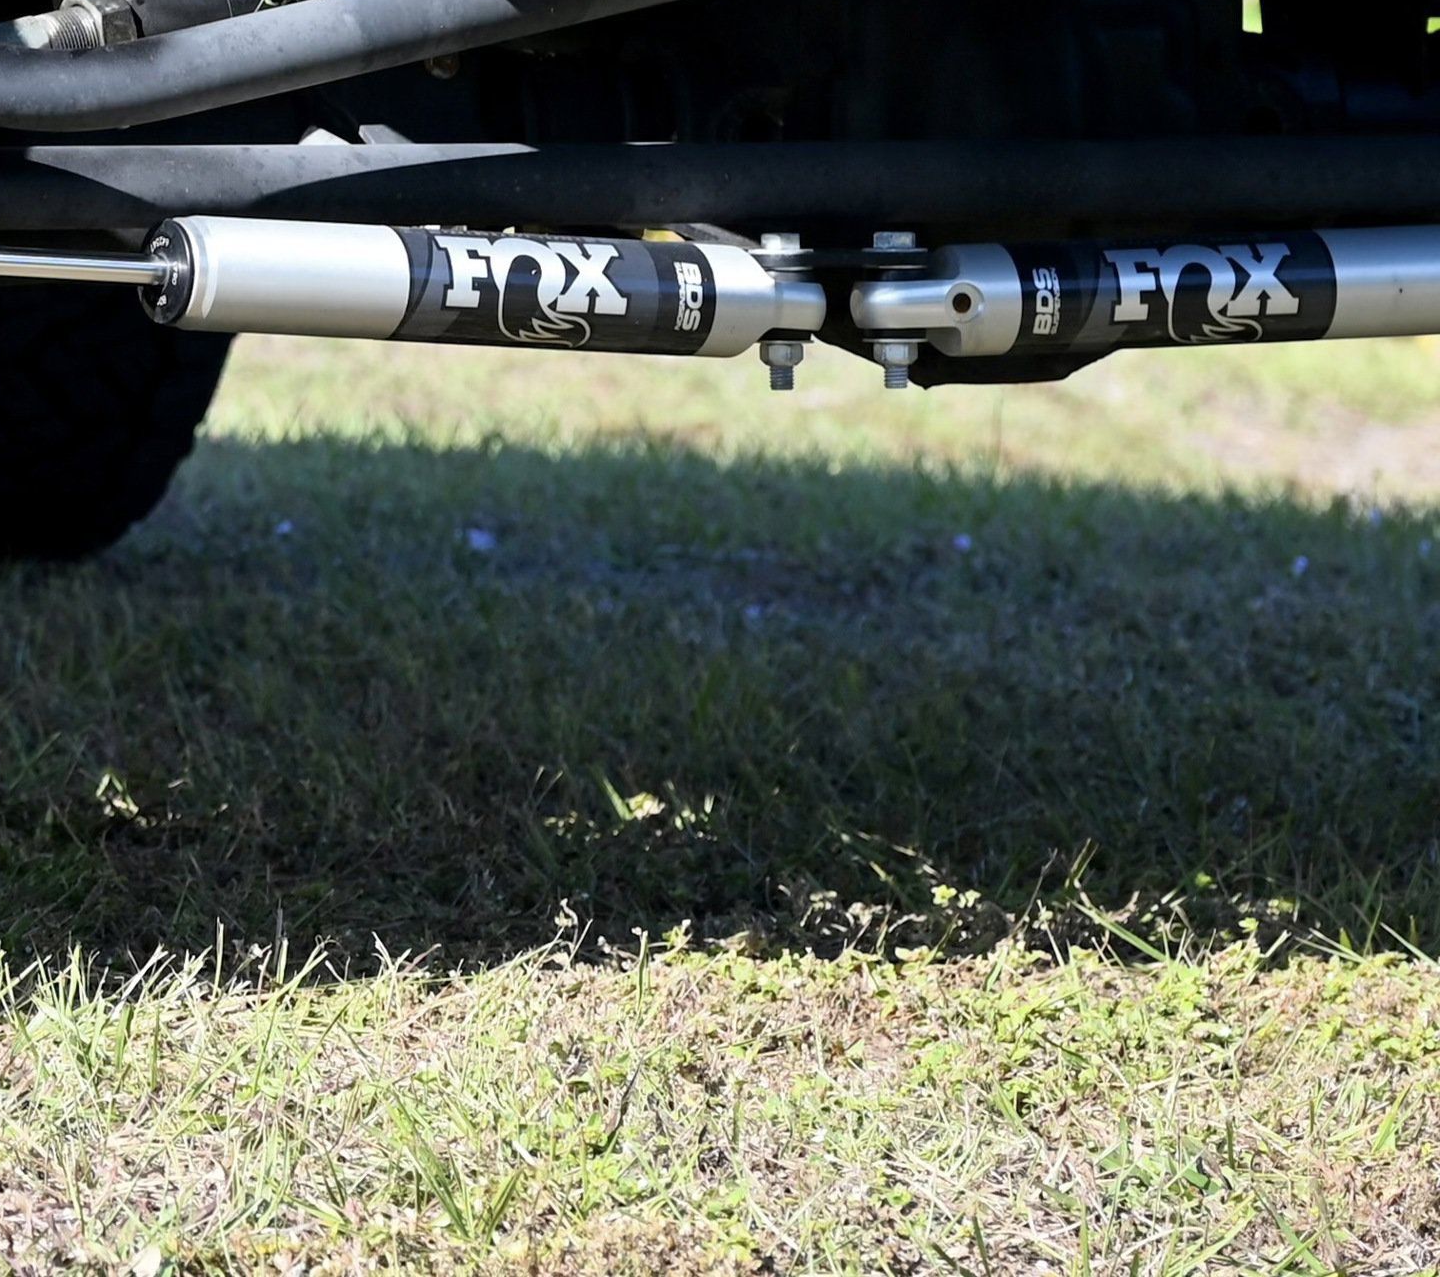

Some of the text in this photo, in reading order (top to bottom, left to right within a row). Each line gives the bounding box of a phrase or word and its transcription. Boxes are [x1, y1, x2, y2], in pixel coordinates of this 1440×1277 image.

[434, 234, 628, 347] FOX
[681, 261, 704, 332] BDS
[1032, 268, 1053, 335] BDS
[1103, 243, 1300, 343] FOX
